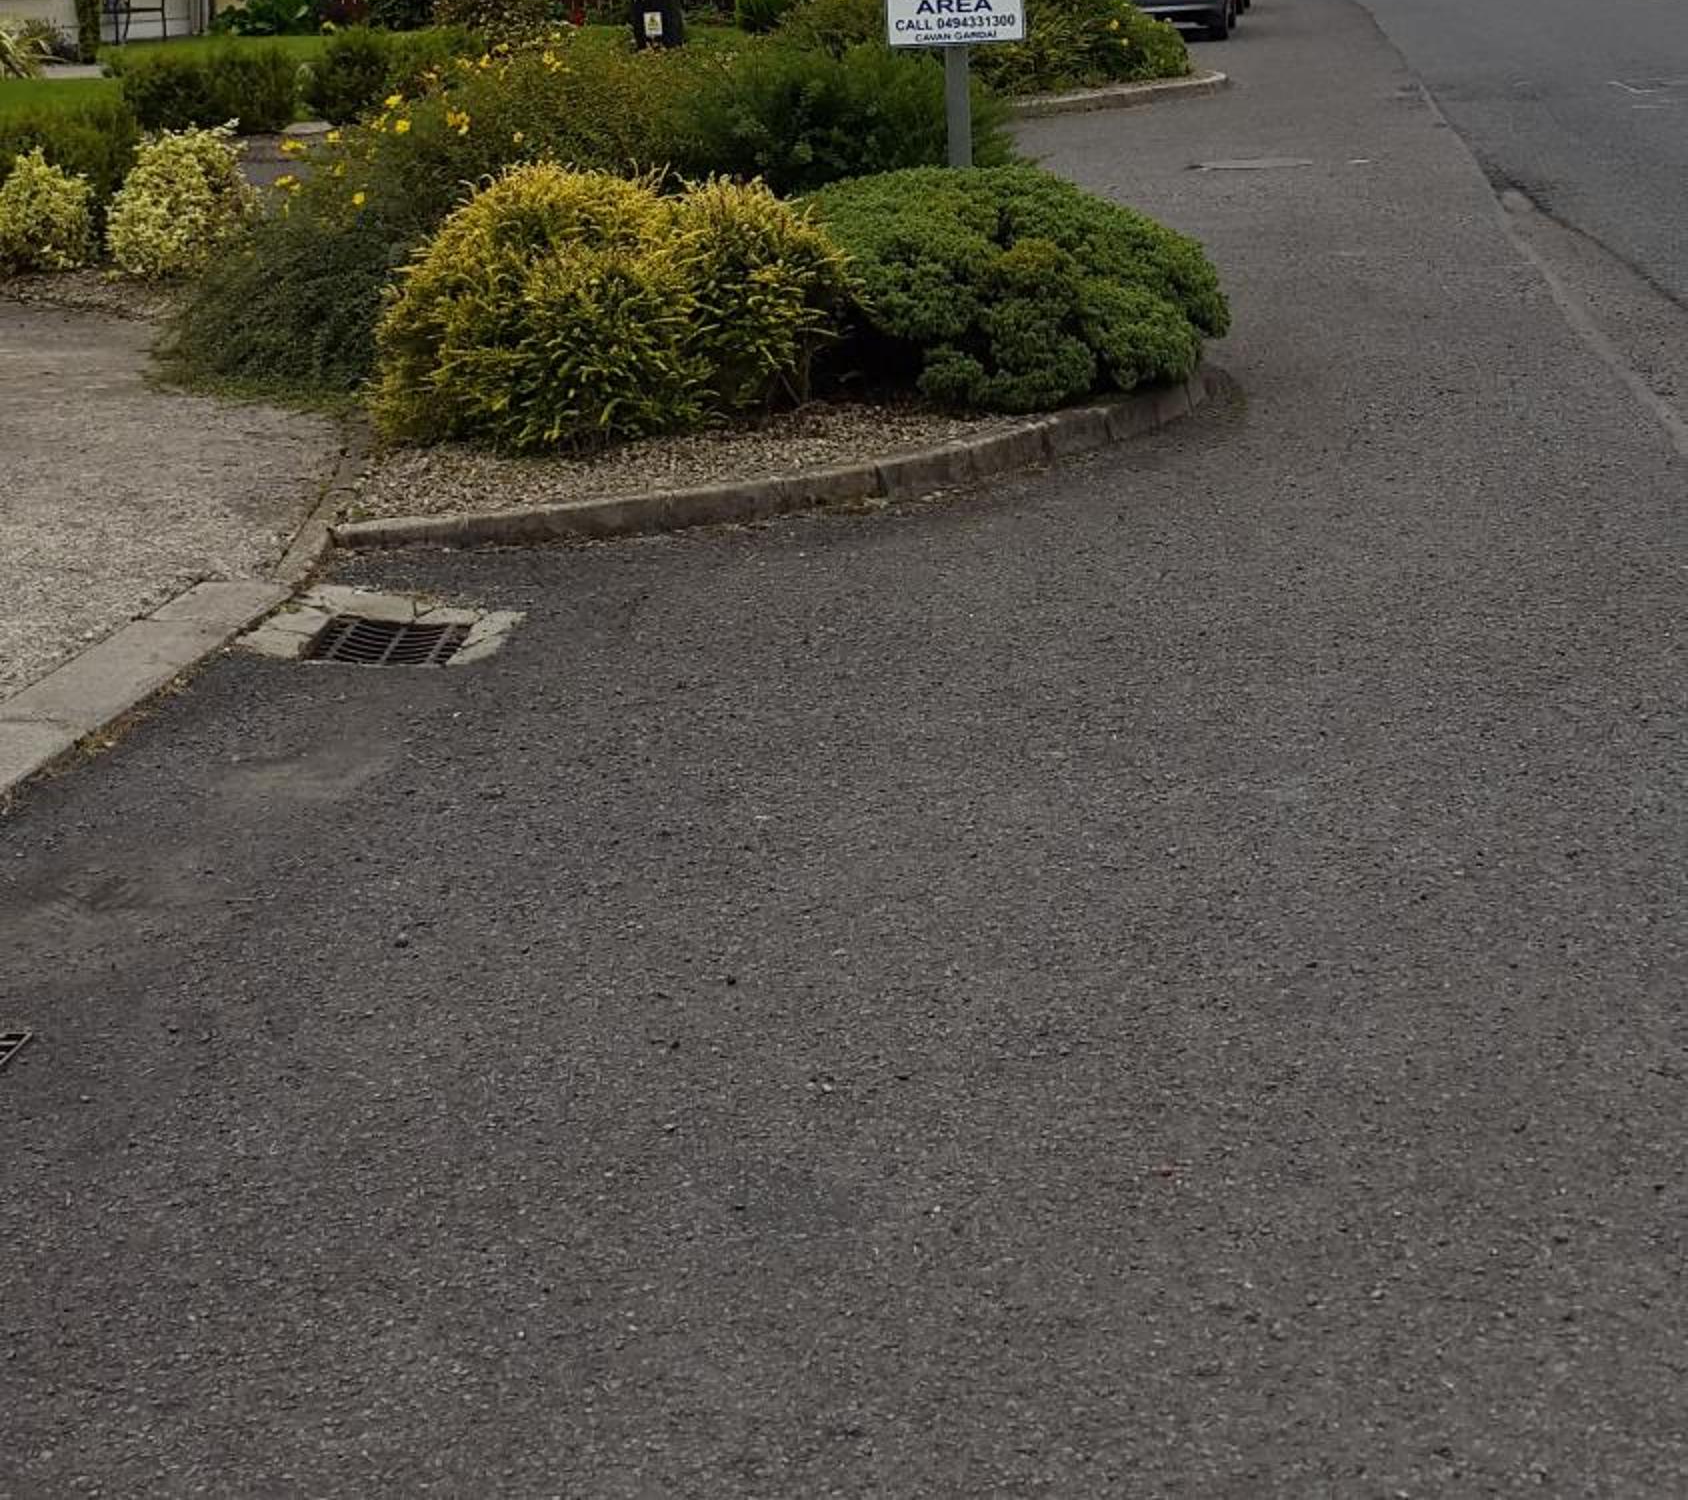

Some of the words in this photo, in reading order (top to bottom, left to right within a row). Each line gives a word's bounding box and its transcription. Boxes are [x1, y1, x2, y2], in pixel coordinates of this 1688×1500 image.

[895, 19, 933, 31] CALL
[937, 13, 1016, 30] 0494331300
[915, 32, 951, 43] CAVAN
